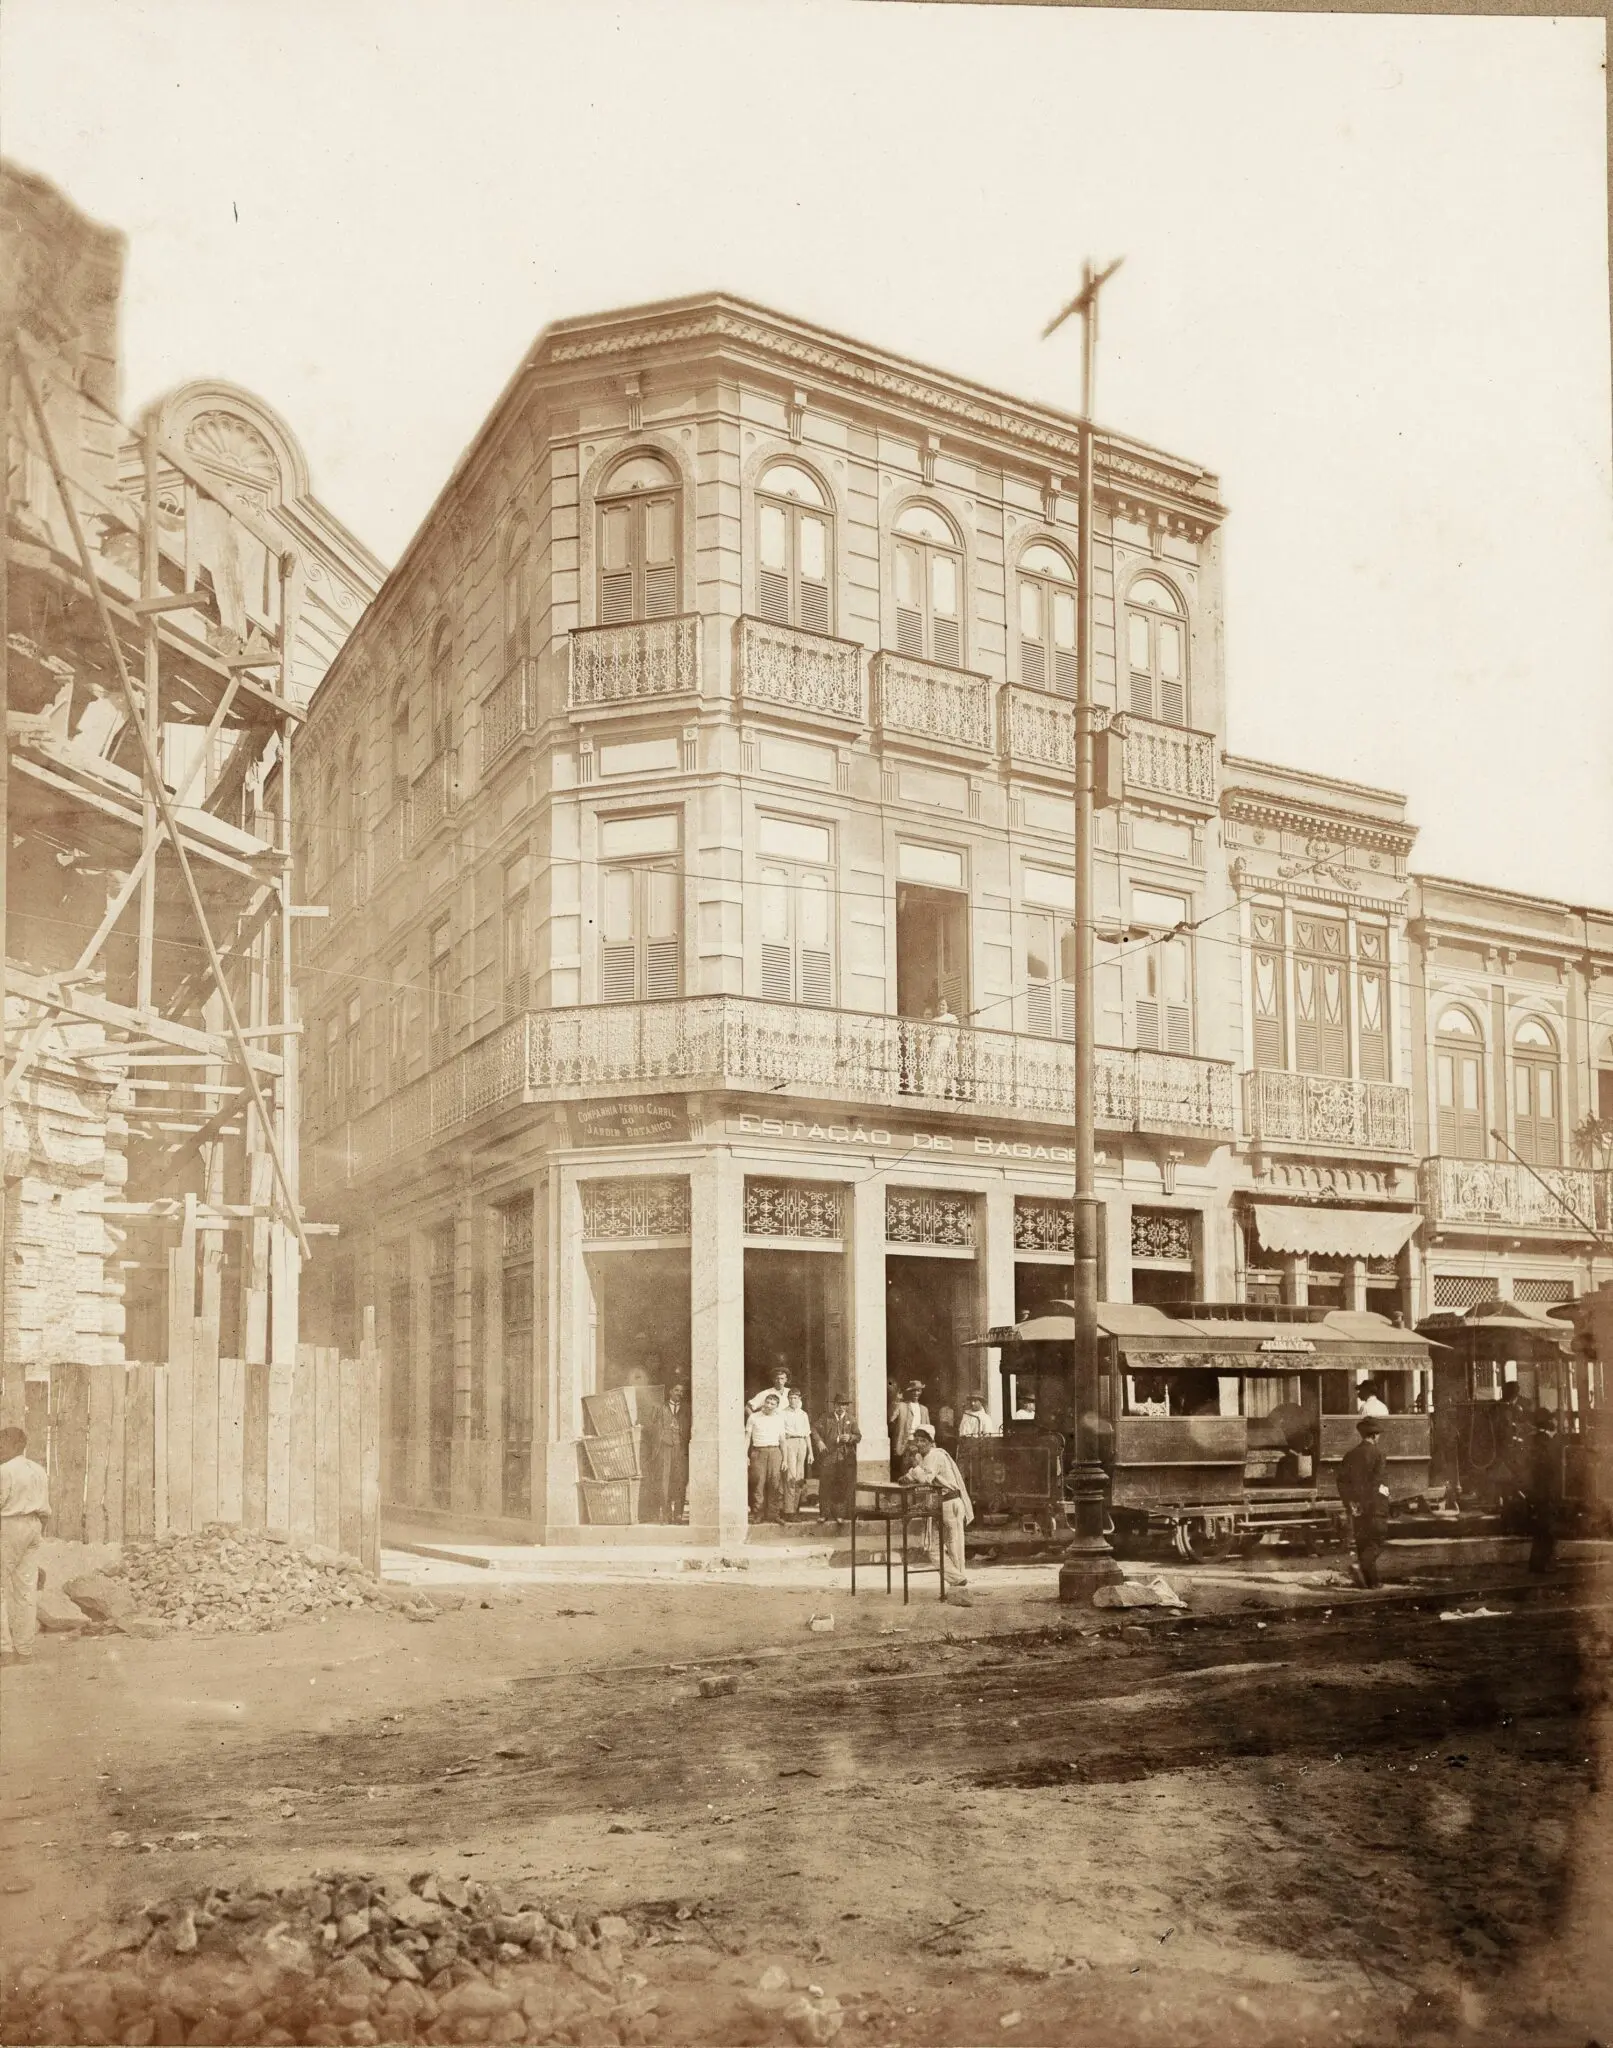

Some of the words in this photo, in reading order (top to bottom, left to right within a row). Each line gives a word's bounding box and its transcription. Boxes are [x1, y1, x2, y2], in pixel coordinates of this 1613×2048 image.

[618, 1103, 645, 1114] FERRO
[646, 1102, 677, 1118] CARRIL
[621, 1117, 634, 1125] DO
[739, 1112, 892, 1146] ESTAÇÃO
[913, 1133, 953, 1152] DE
